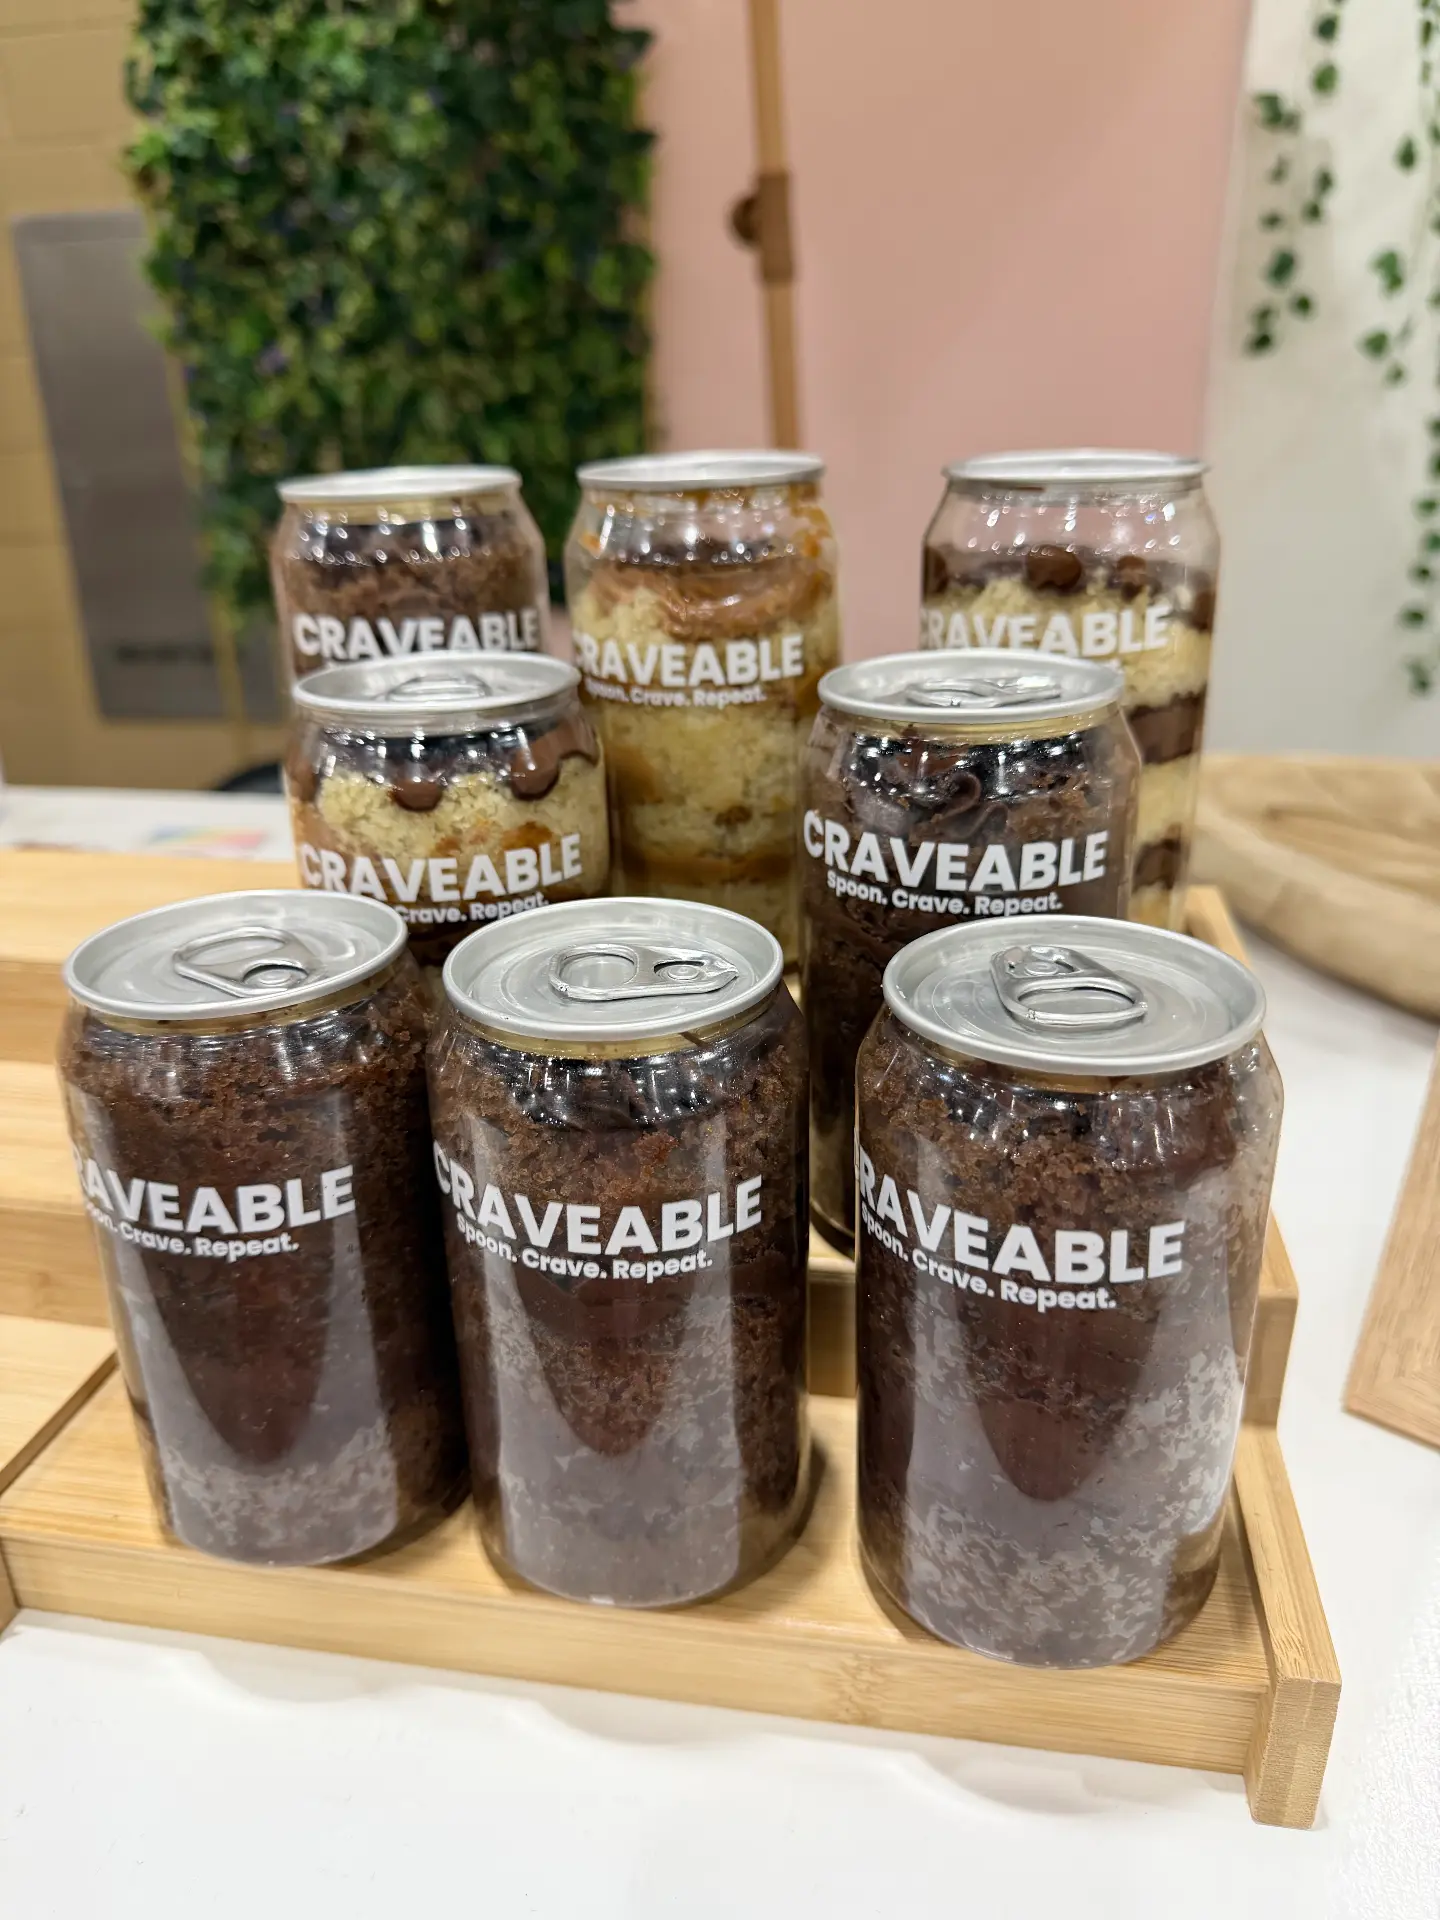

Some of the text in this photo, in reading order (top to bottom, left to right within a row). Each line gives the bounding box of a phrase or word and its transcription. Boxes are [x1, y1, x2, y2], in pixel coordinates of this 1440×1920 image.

[293, 608, 541, 661] CRAVEABLE
[692, 683, 767, 711] Repeat.
[302, 832, 583, 904] CRAVEABLE
[802, 809, 1109, 892] CRAVEABLE
[469, 891, 549, 922] Repeat.
[827, 869, 1063, 917] Spoon. Crave. Repeat.
[86, 1157, 356, 1235] AVEABLE
[433, 1139, 763, 1256] CRAVEABLE
[860, 1143, 1185, 1284] RAVEABLE
[119, 1221, 193, 1255] Crave.
[194, 1232, 300, 1263] Repeat.
[456, 1211, 713, 1284] Spoon. Crave. Repeat.
[862, 1200, 1117, 1313] Spoon. Crave. Repeat.
